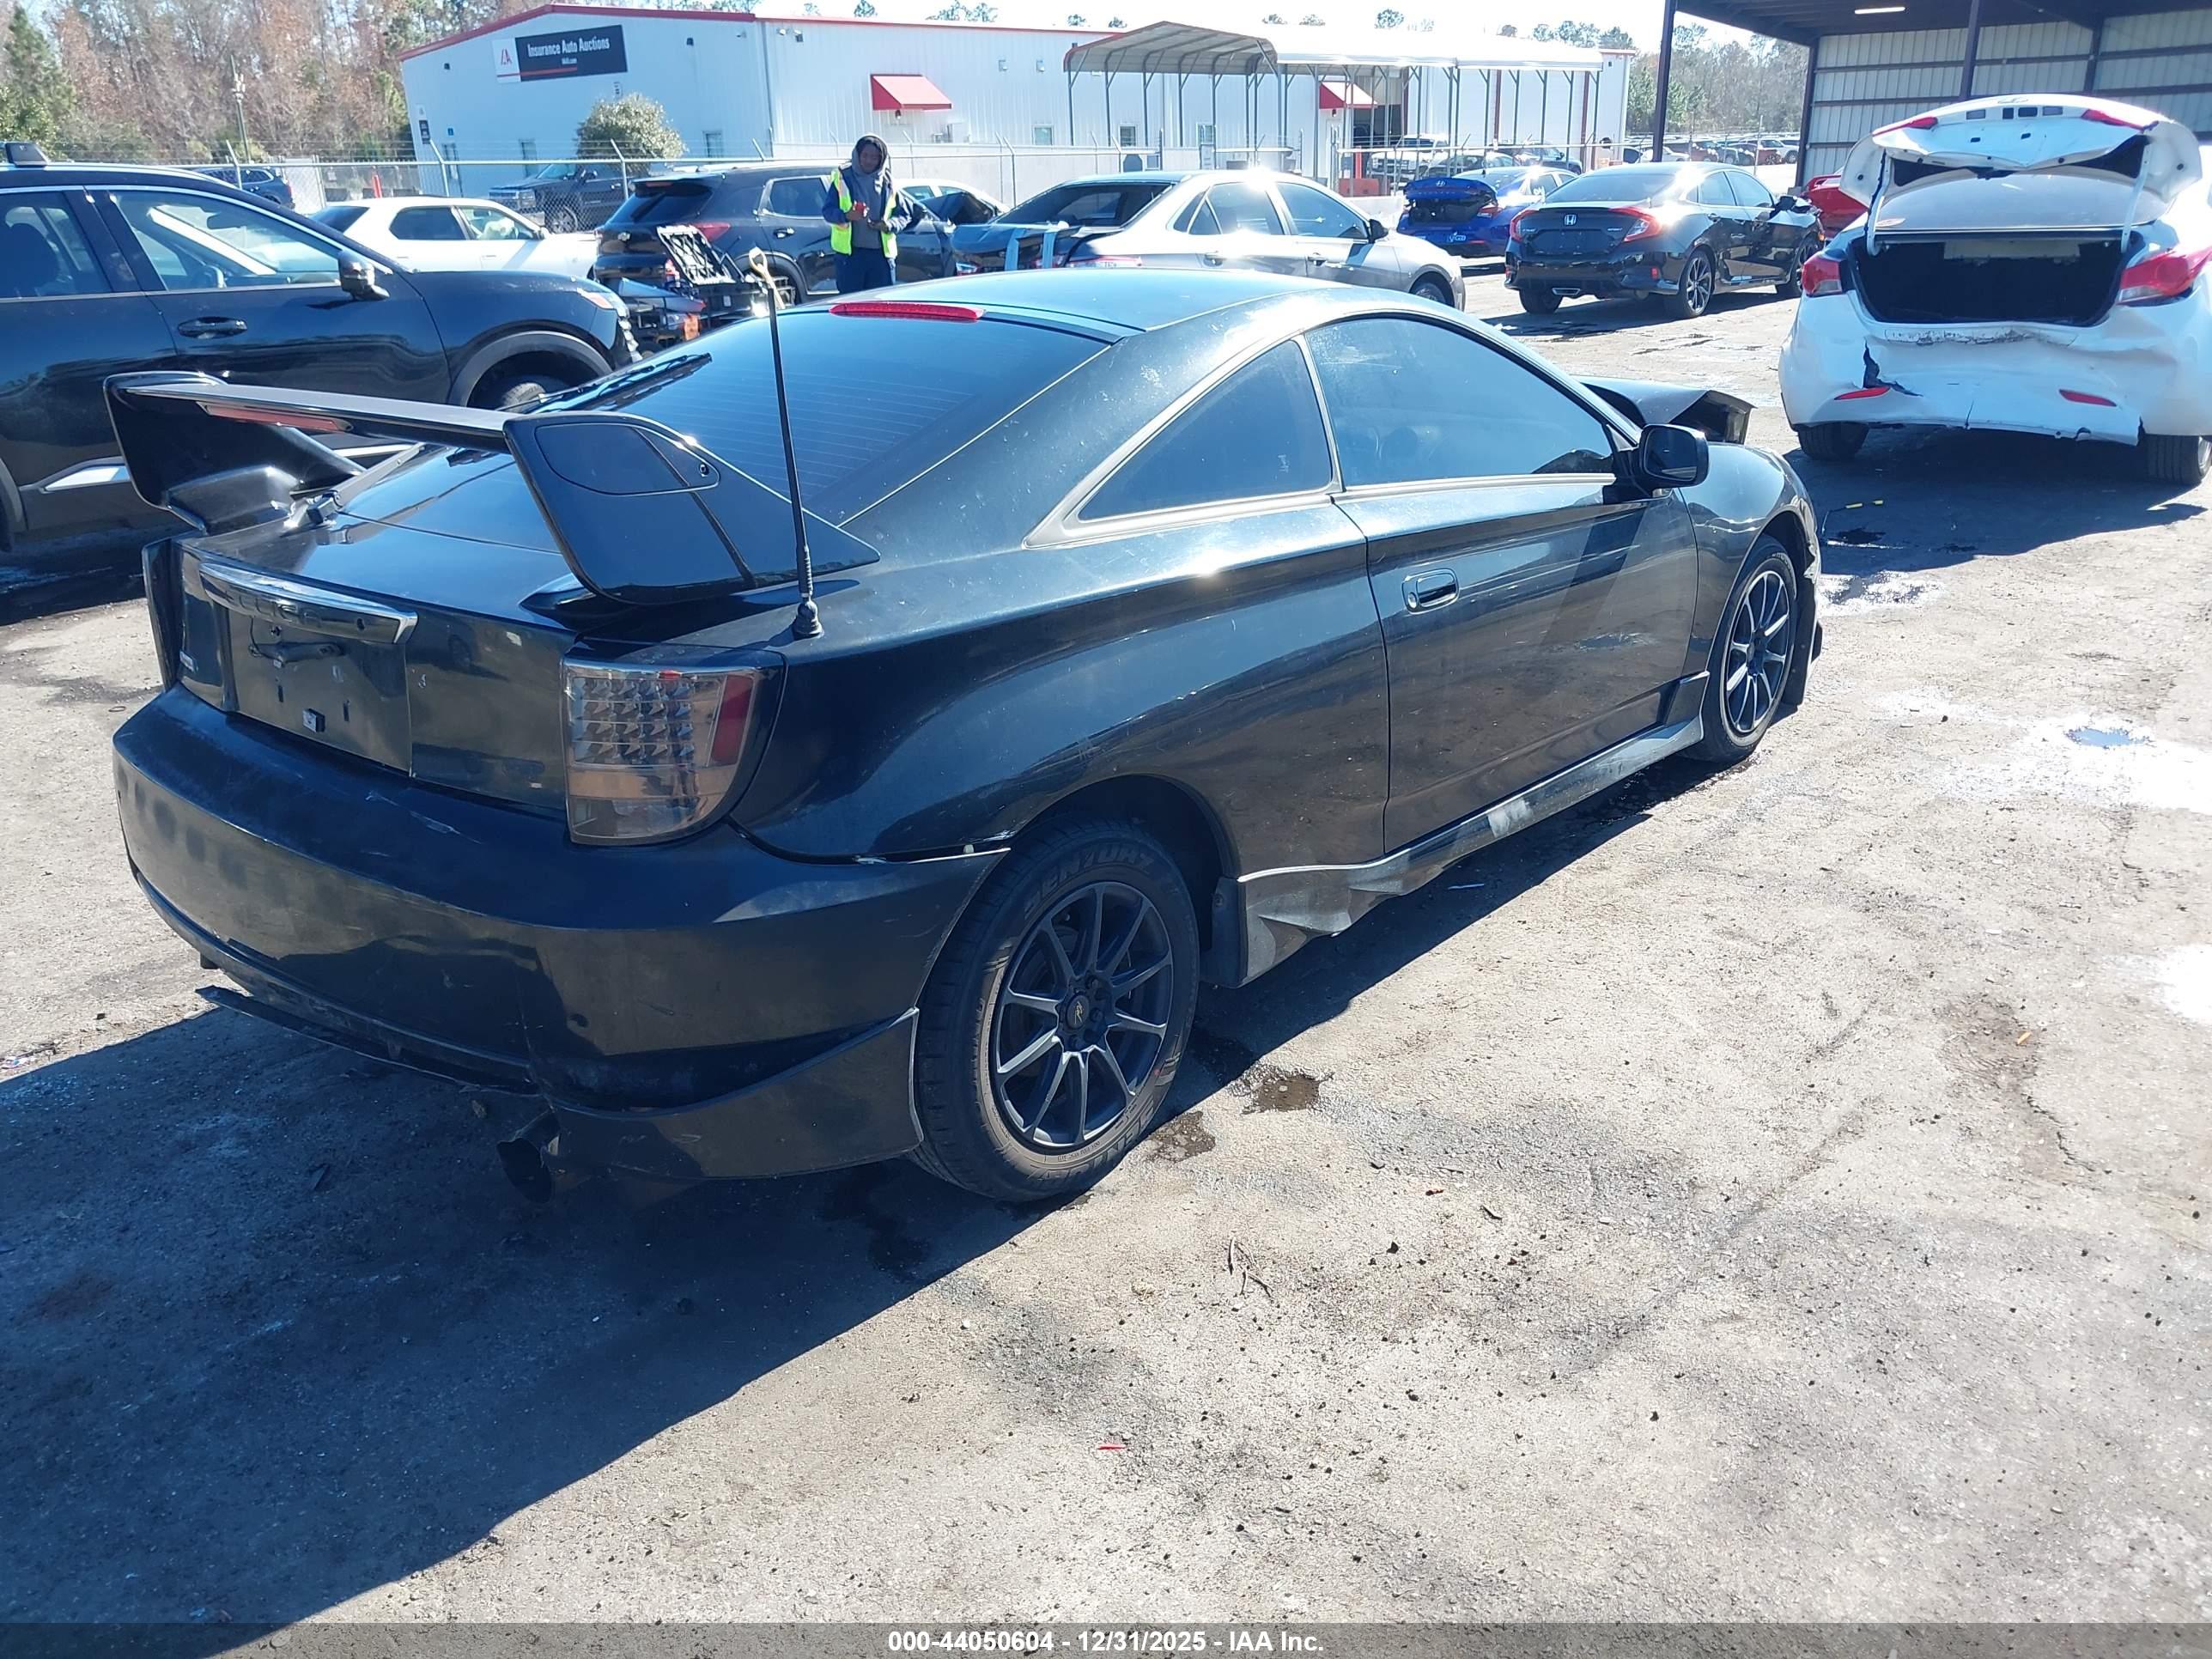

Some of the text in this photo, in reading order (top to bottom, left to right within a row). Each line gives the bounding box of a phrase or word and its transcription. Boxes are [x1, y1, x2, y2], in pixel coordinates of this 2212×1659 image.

[527, 44, 561, 58] Insurance
[562, 40, 578, 53] Auto
[579, 37, 610, 52] Auctions
